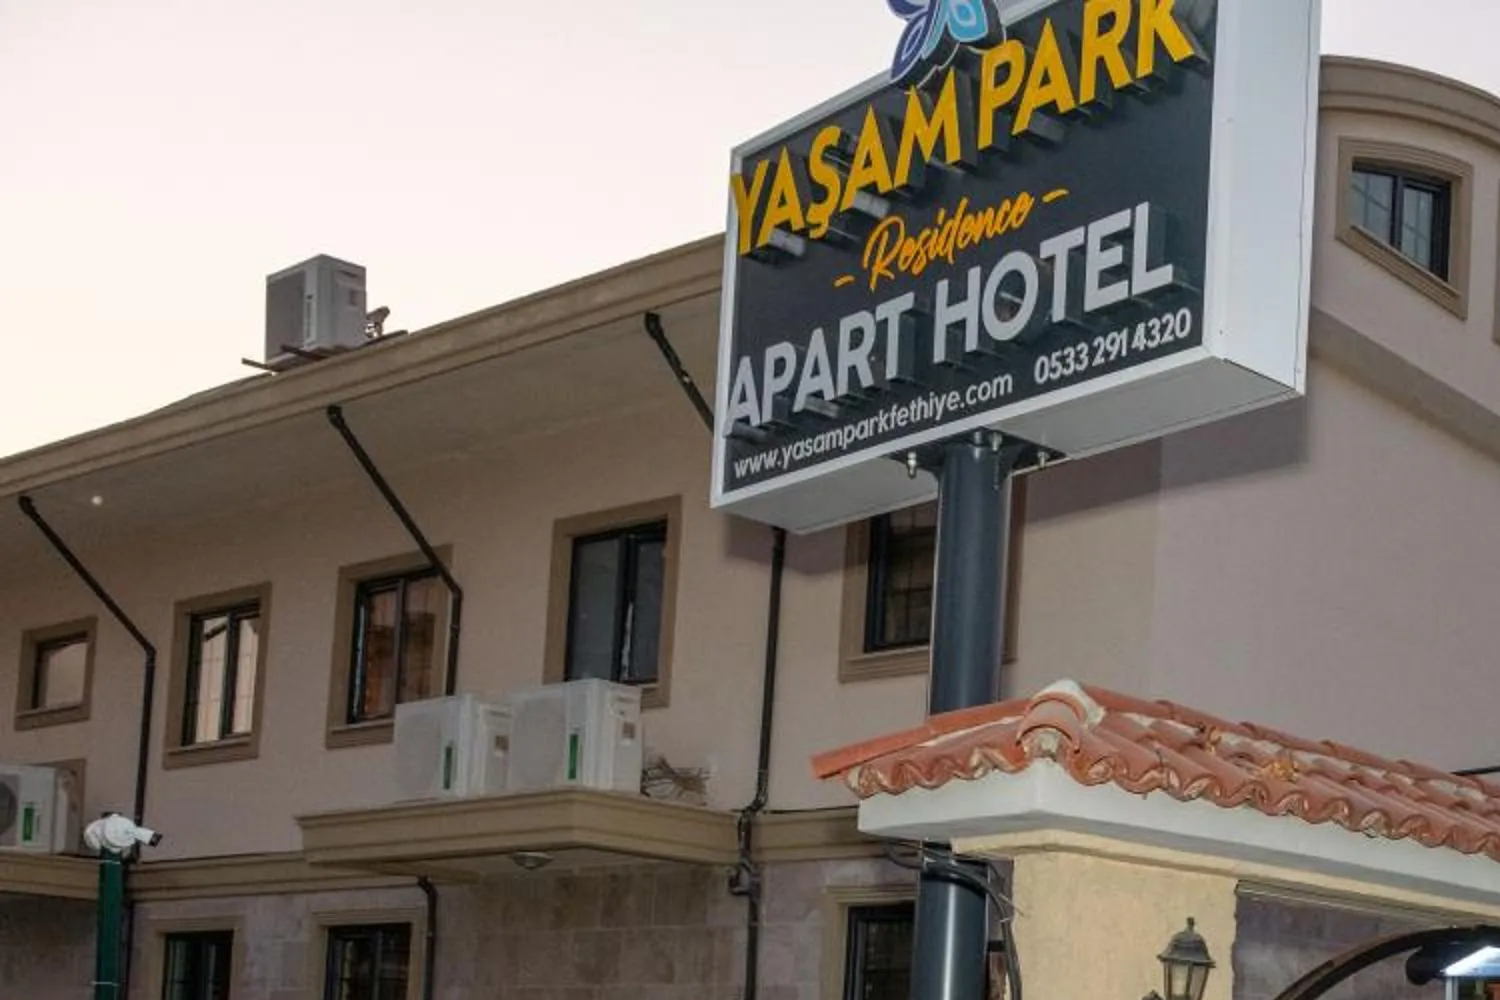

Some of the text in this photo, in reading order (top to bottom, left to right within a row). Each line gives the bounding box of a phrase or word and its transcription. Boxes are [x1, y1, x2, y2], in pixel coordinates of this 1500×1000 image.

[730, 0, 1194, 255] YAŞAM PARK
[863, 191, 1034, 292] Residence
[724, 202, 1173, 437] APART HOTEL
[1034, 307, 1192, 384] 0533 291 4320
[734, 373, 1013, 478] www.yasamparkfethiye.com
